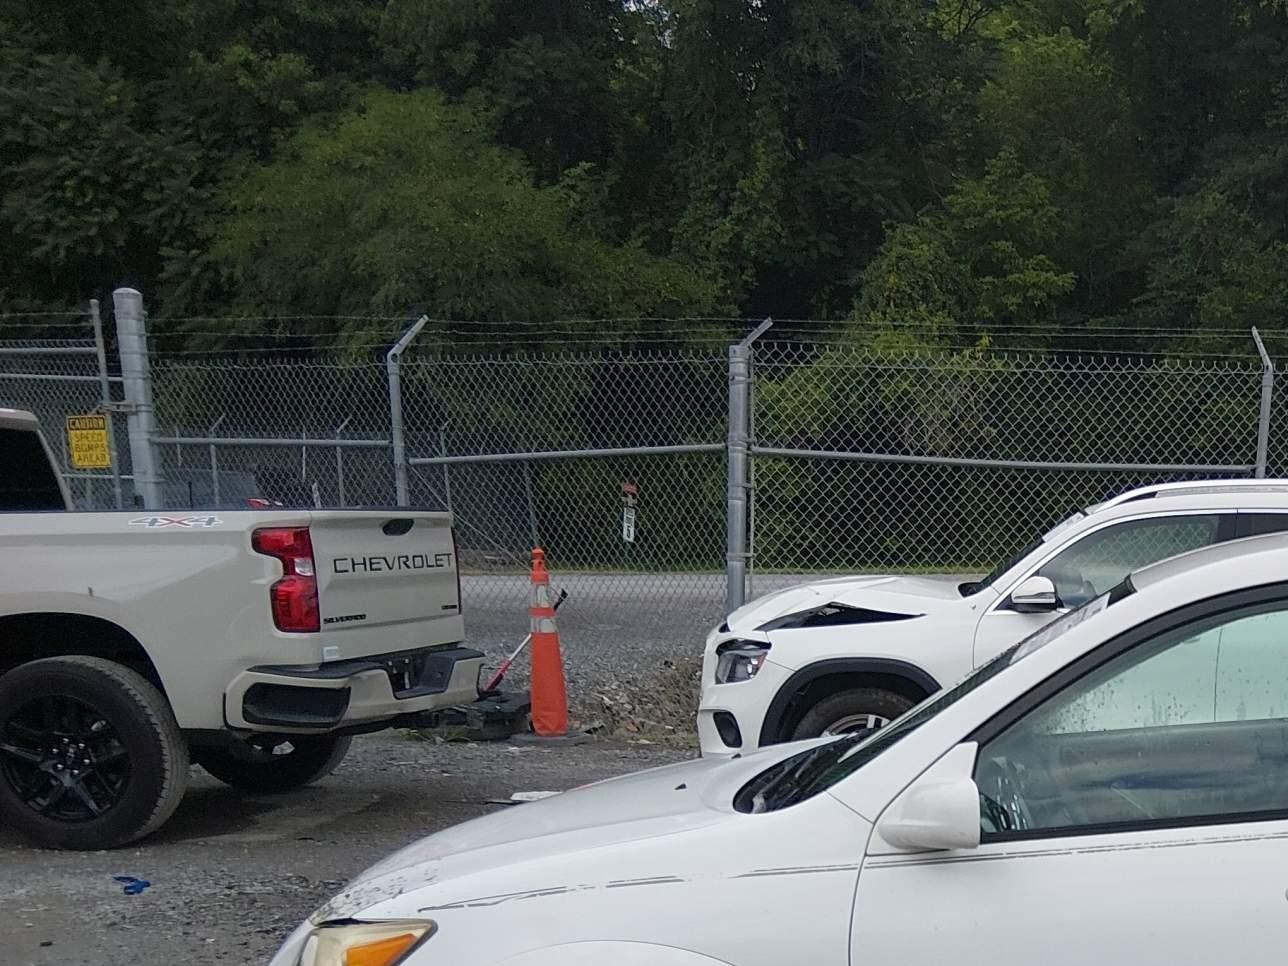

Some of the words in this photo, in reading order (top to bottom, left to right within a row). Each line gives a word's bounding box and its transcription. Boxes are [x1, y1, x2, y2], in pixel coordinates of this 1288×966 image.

[69, 418, 104, 429] CAUTION
[74, 432, 102, 442] SPEED
[75, 443, 106, 453] BUMPS
[76, 453, 106, 462] AHEAD
[333, 553, 452, 574] CHEVROLET
